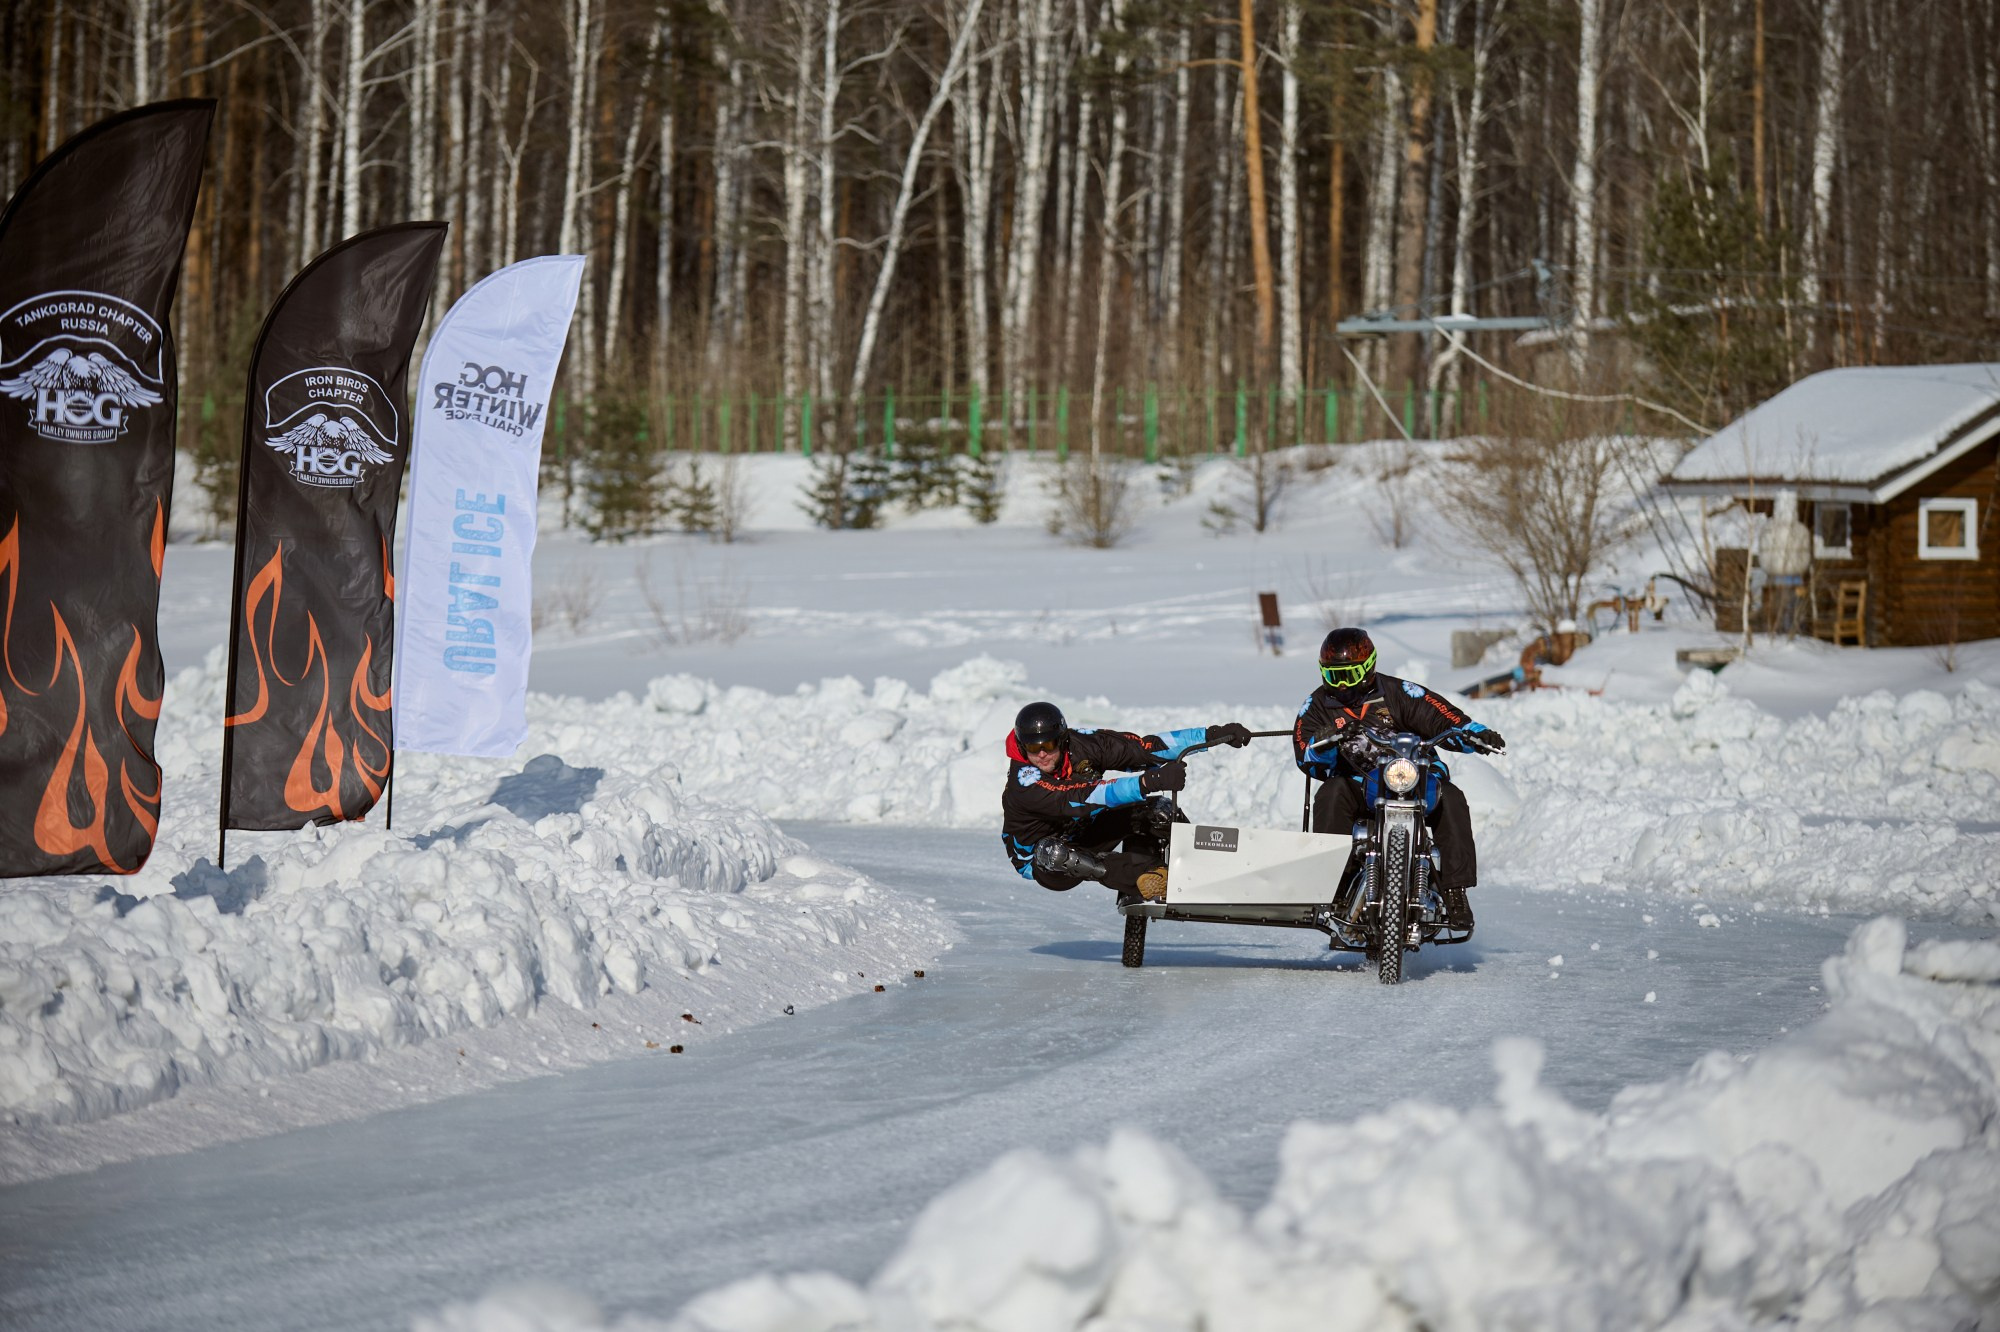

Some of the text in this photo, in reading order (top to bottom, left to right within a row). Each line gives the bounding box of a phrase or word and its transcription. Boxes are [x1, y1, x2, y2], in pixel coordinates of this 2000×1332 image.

[15, 302, 153, 344] TANKOGRAD CHAPTER
[60, 318, 109, 336] RUSSIA
[305, 375, 369, 393] IRON BIRDS
[308, 388, 364, 404] CHAPTER
[42, 424, 115, 440] HARLEY OWNERS GROUP
[299, 473, 318, 483] HARLEY
[317, 476, 339, 485] OWNERS
